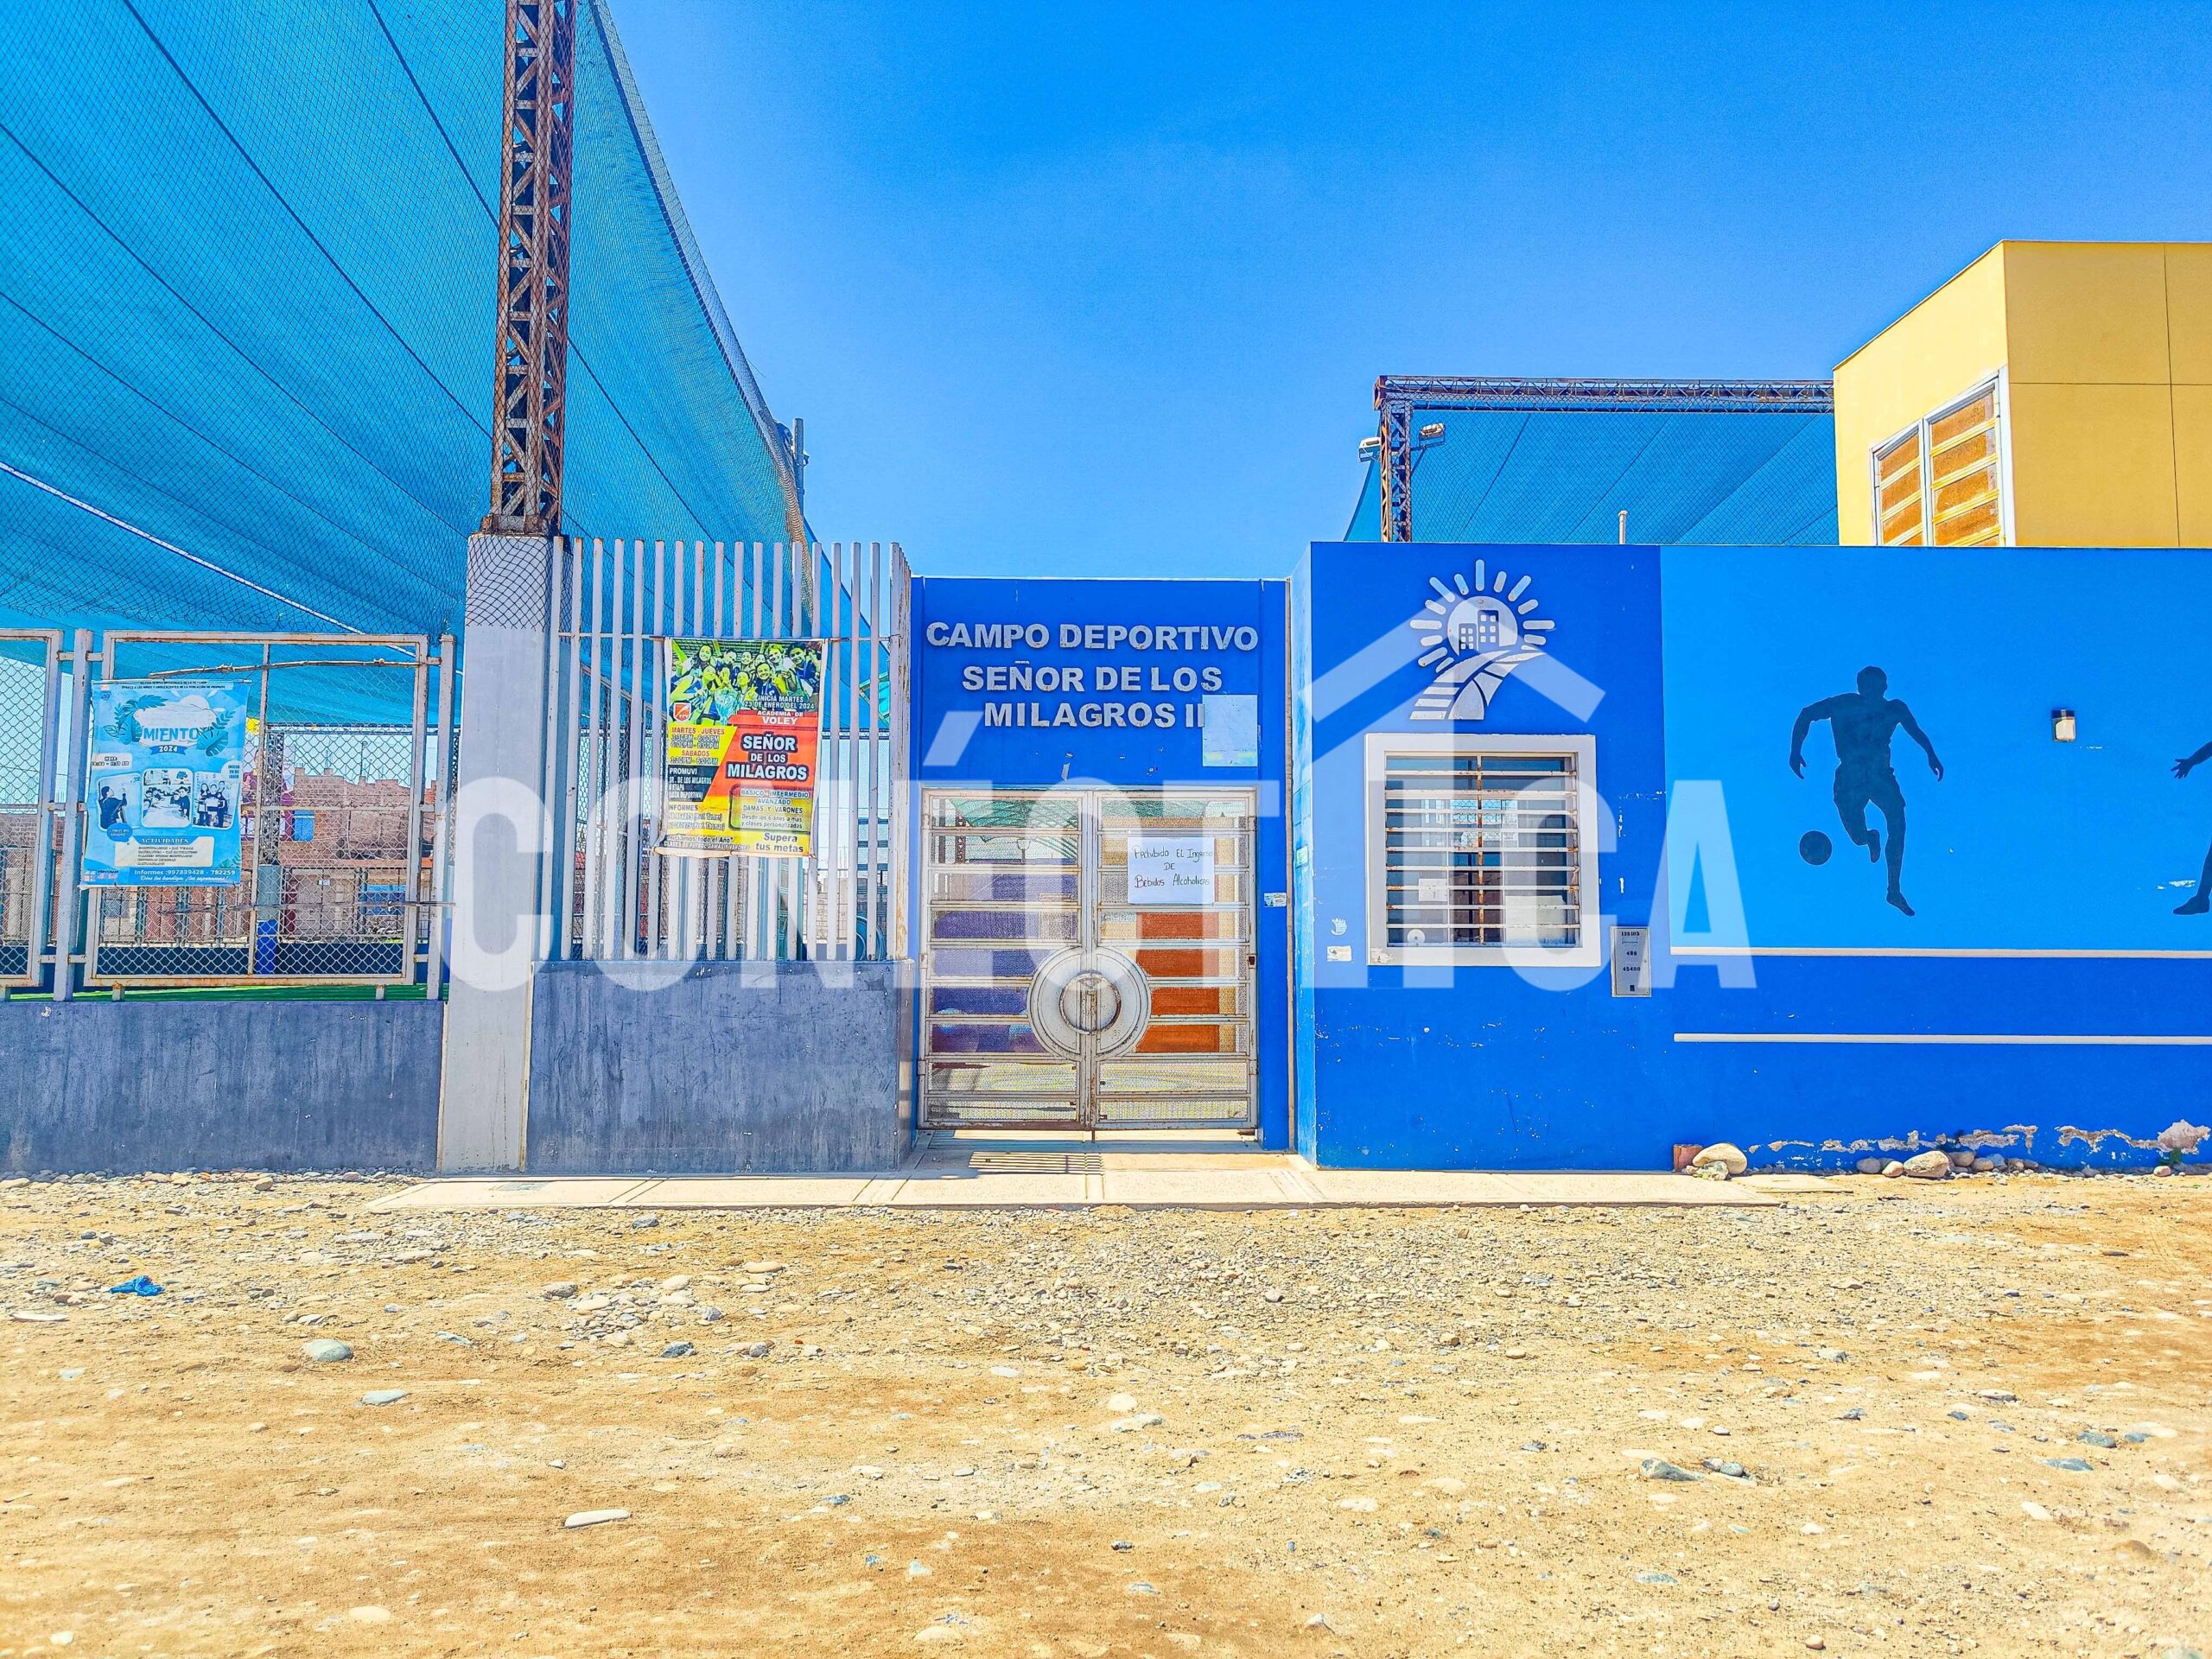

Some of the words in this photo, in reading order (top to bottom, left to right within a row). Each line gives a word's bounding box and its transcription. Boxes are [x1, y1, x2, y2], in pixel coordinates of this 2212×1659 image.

[926, 622, 1050, 648] CAMPO
[1058, 624, 1259, 652] DEPORTIVO
[962, 660, 1084, 692] SEÑOR
[1096, 666, 1141, 691] DE
[1150, 666, 1223, 692] LOS
[762, 716, 798, 725] VOLEY
[983, 702, 1176, 728] MILAGROS
[743, 733, 795, 751] SEÑOR
[751, 753, 763, 762] DE
[768, 753, 786, 763] LOS
[728, 764, 807, 780] MILAGROS
[764, 832, 798, 843] Supera
[755, 842, 771, 851] tus
[773, 843, 804, 853] metas
[1163, 861, 1176, 871] DE
